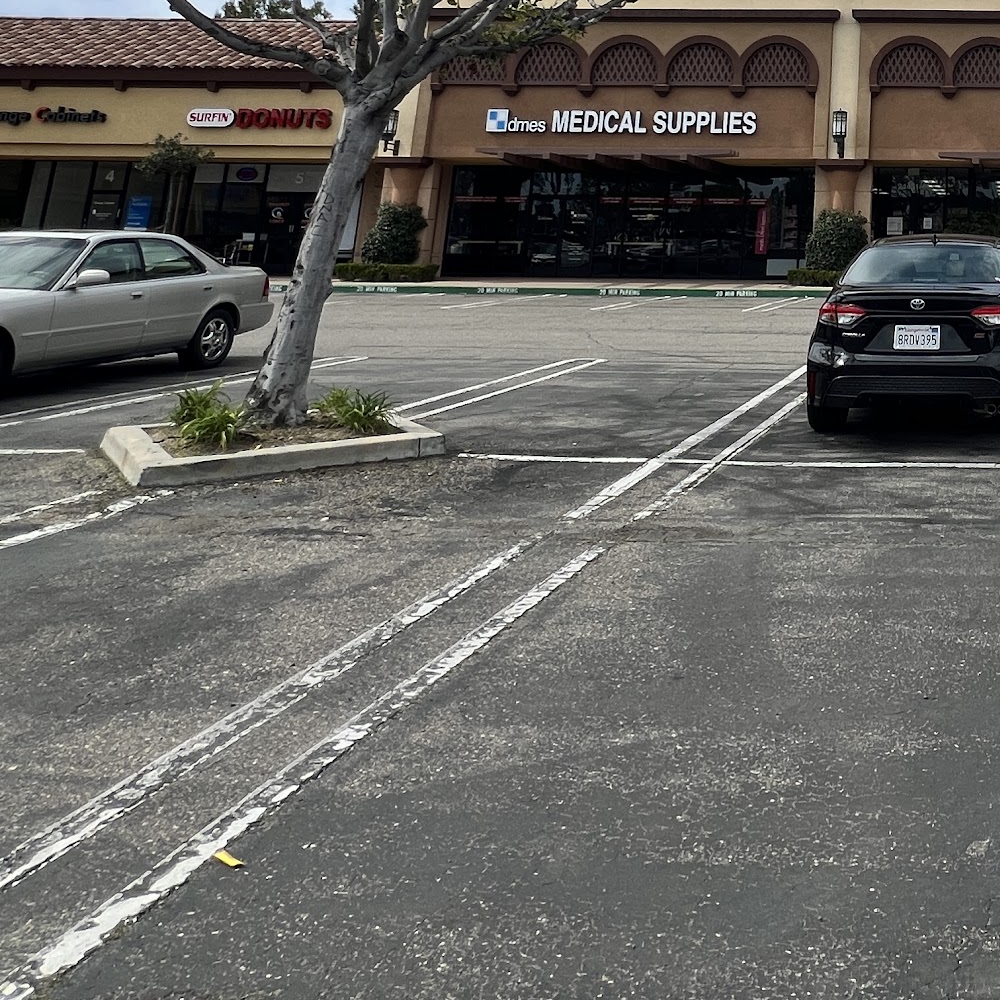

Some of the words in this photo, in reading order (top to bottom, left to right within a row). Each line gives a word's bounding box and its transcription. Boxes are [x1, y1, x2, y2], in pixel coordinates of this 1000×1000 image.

[34, 105, 107, 123] Cabinets
[235, 108, 333, 130] DONUTS
[507, 116, 546, 133] dmes
[551, 109, 647, 134] MEDICAL
[652, 110, 757, 135] SUPPLIES
[105, 169, 115, 182] 4
[295, 172, 304, 184] 5
[897, 334, 937, 345] 8RDV395
